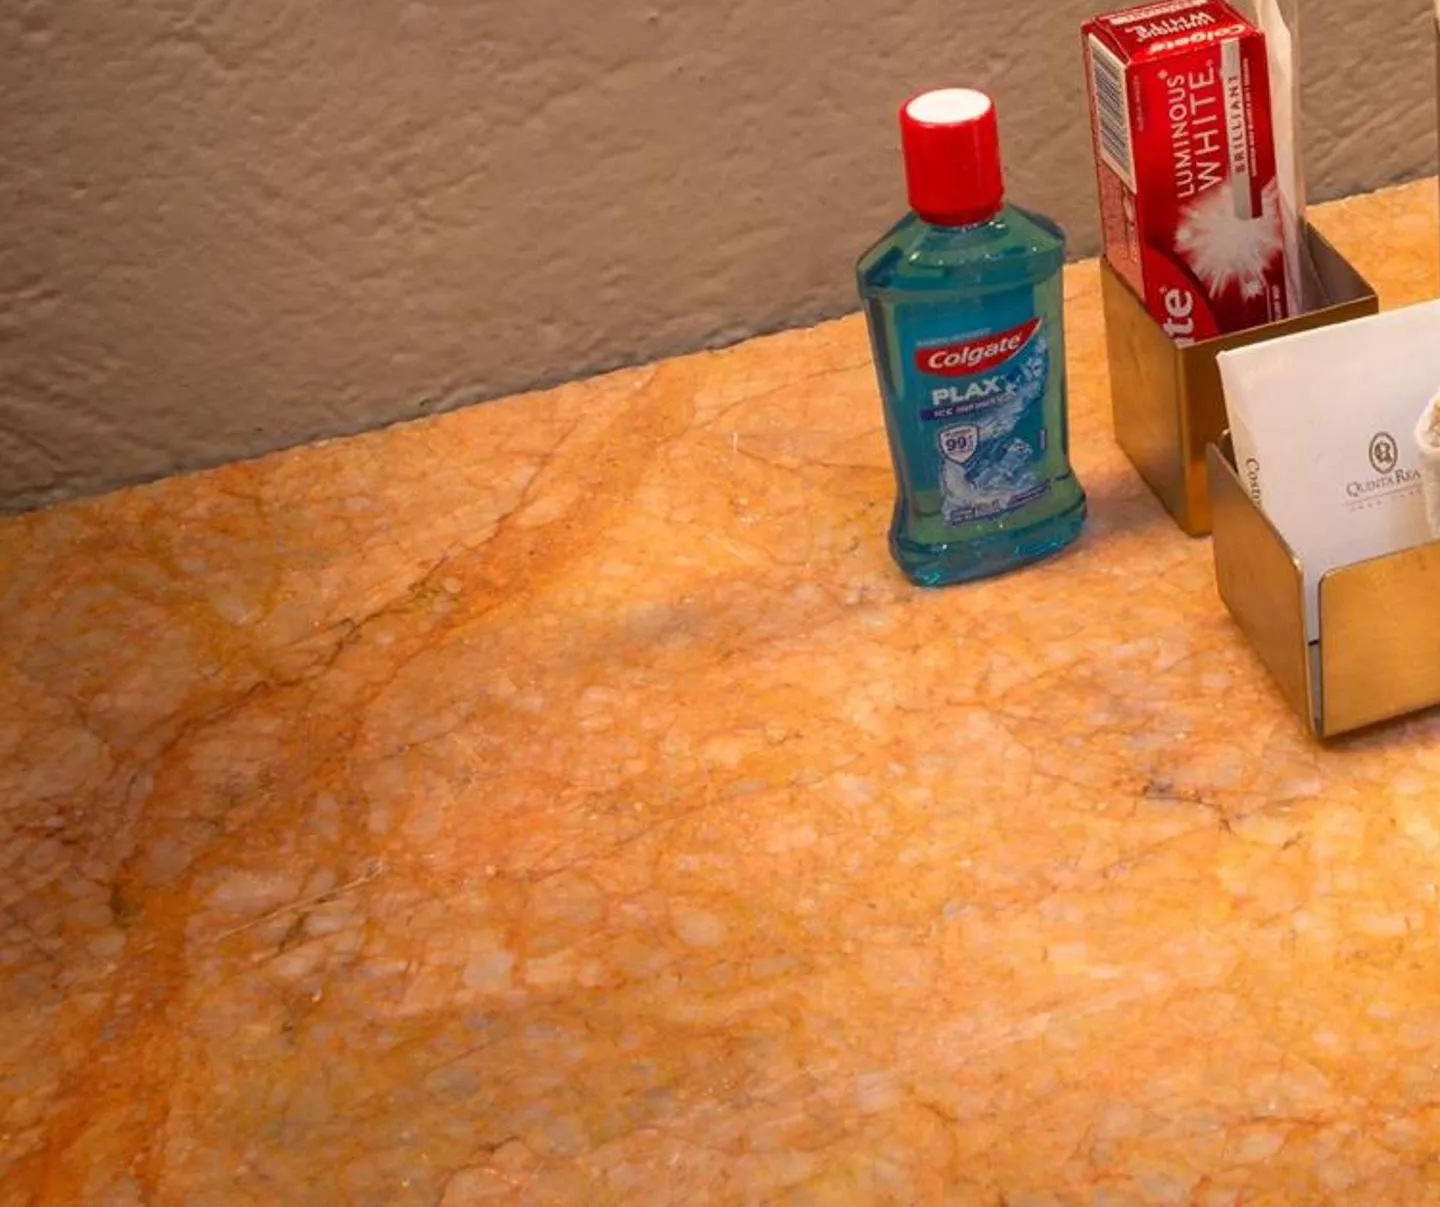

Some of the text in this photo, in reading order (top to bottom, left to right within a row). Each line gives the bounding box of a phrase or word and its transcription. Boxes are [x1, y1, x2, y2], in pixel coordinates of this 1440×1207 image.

[1166, 74, 1196, 198] LUMINOUS
[1188, 67, 1223, 192] WHITE
[1228, 76, 1245, 174] BRILLIANT
[1163, 289, 1195, 348] te
[928, 333, 1021, 369] Colgate
[931, 376, 1001, 406] PLAX
[1394, 468, 1421, 486] REA
